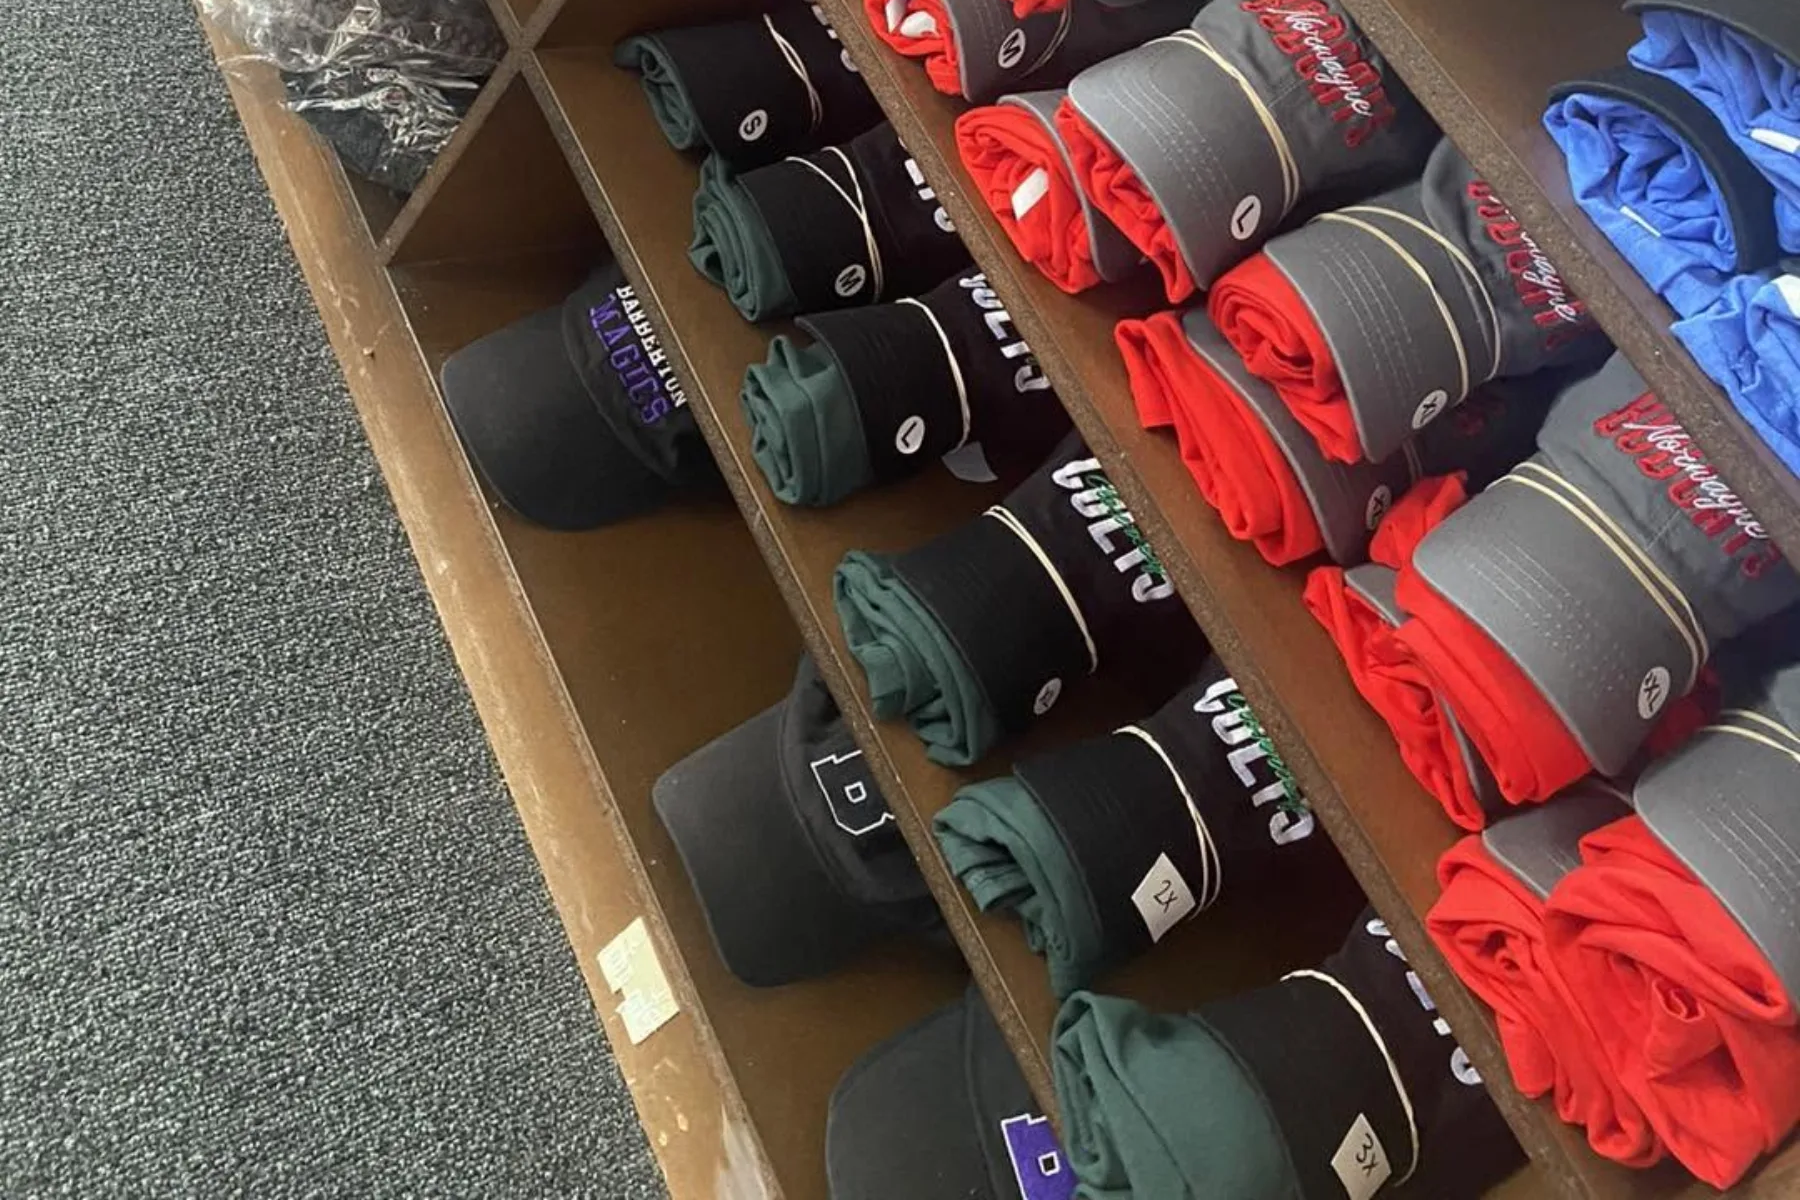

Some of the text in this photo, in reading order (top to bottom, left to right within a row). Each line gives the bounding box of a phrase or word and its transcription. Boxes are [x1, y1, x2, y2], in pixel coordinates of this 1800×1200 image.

[1001, 32, 1024, 64] M
[1266, 5, 1373, 119] Norwayne
[1235, 202, 1256, 234] L
[838, 271, 863, 293] M
[588, 294, 671, 426] MAGICS
[1623, 421, 1771, 541] Norwayne
[1051, 456, 1175, 603] COLTS
[1153, 878, 1179, 914] 2X
[1355, 1132, 1381, 1176] 3X
